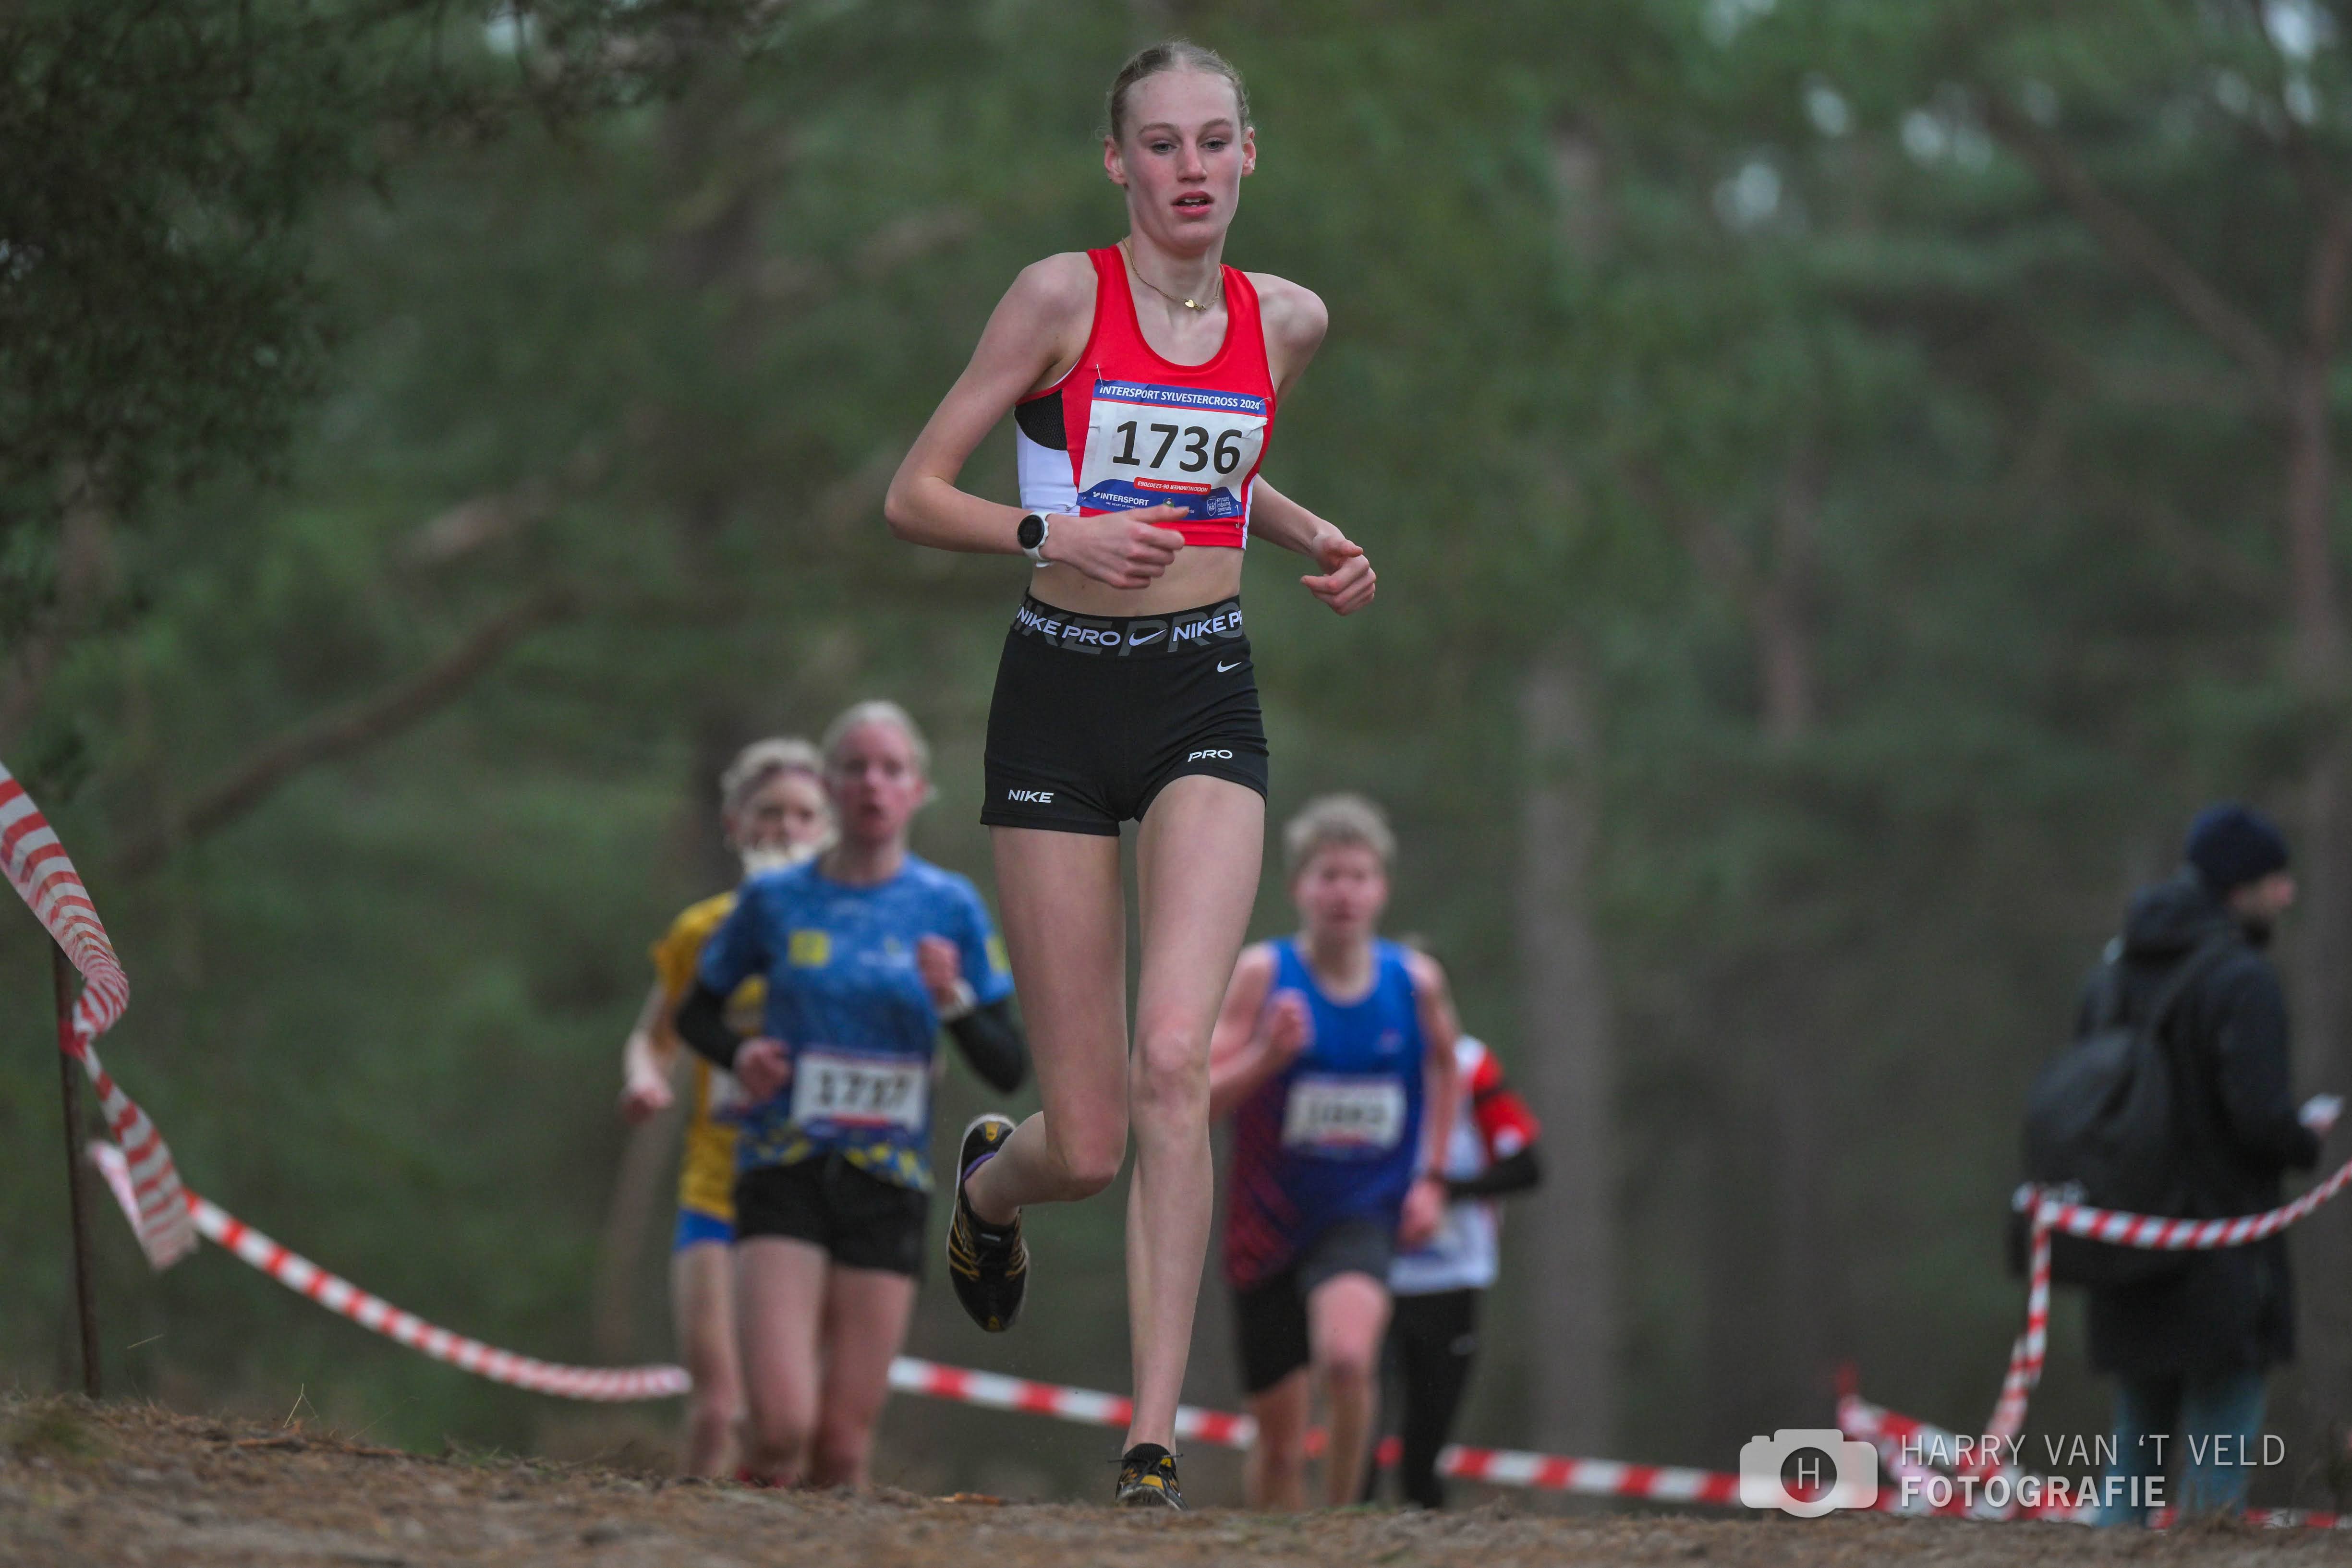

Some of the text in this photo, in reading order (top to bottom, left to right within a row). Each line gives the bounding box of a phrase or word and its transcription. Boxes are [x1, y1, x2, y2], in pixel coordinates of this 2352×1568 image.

[1161, 391, 1238, 407] SYLVESTERCROSS
[1240, 399, 1260, 410] 2024
[1113, 421, 1242, 474] 1736
[1100, 493, 1149, 506] INTERSPORT
[1017, 606, 1061, 636] NIKE
[1062, 625, 1121, 646] PRO
[1173, 615, 1226, 642] NIKE
[1188, 749, 1233, 762] PRO
[1008, 789, 1054, 803] NIKE
